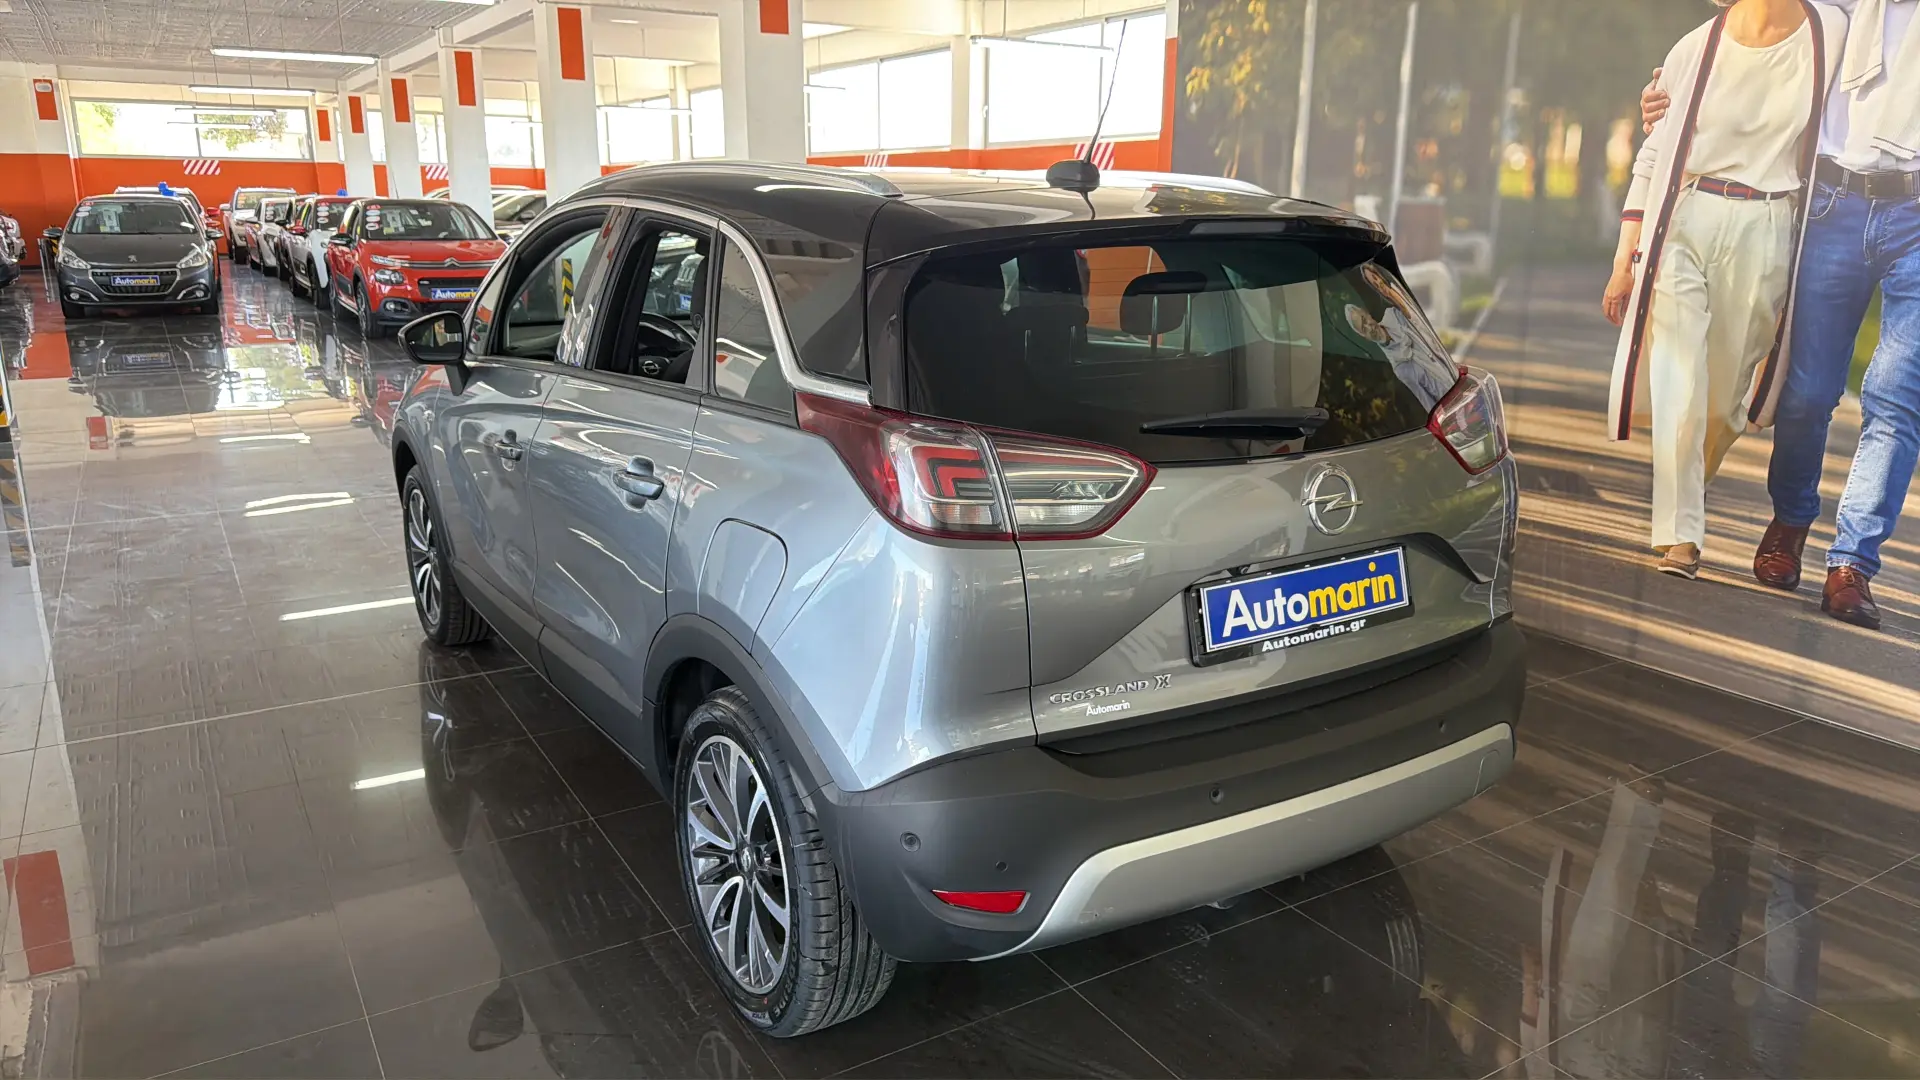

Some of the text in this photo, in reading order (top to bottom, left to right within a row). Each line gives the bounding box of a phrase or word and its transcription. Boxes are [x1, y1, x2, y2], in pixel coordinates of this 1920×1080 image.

[1222, 561, 1397, 638] Automarin
[1261, 617, 1367, 652] Automarin.gr
[1049, 673, 1172, 704] CROSSLAND X
[1085, 699, 1131, 717] Automarin
